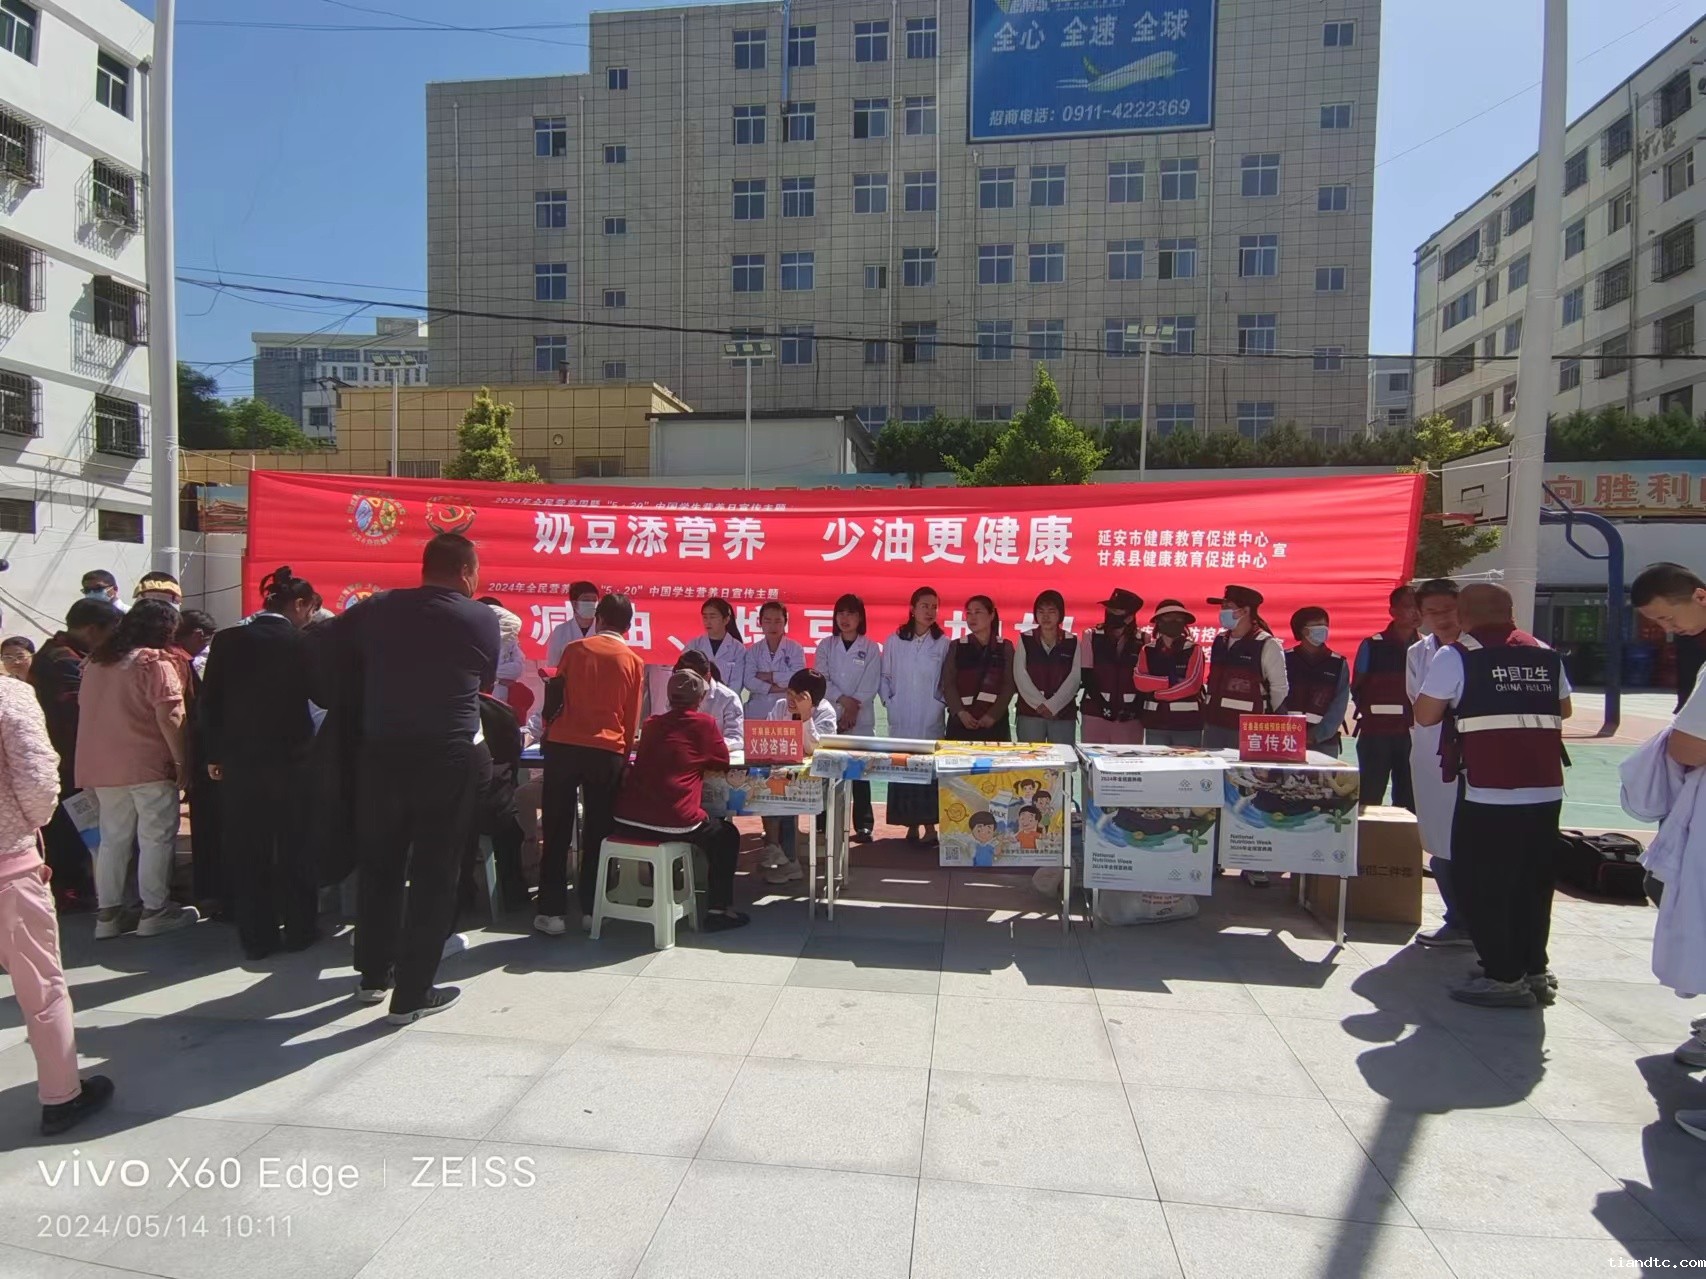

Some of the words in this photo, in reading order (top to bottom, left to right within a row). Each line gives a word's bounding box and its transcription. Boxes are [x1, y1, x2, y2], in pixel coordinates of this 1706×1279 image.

[992, 20, 1046, 52] 全心
[1061, 14, 1119, 47] 全速
[1132, 8, 1190, 43] 全球
[1544, 473, 1706, 505] 向胜利
[533, 511, 766, 561] 奶豆添营养
[821, 515, 1073, 566] 少油更健康
[1097, 529, 1270, 548] 延安市健康教育促进中心
[1097, 549, 1268, 569] 甘泉县健康教育促进中心
[1272, 542, 1288, 558] 宣
[650, 585, 779, 600] 中国学生营养日宣传主题
[1492, 666, 1550, 682] 中国卫生
[1496, 683, 1522, 692] CHINA
[750, 737, 798, 756] 义诊咨询台
[1247, 733, 1297, 753] 宣传处
